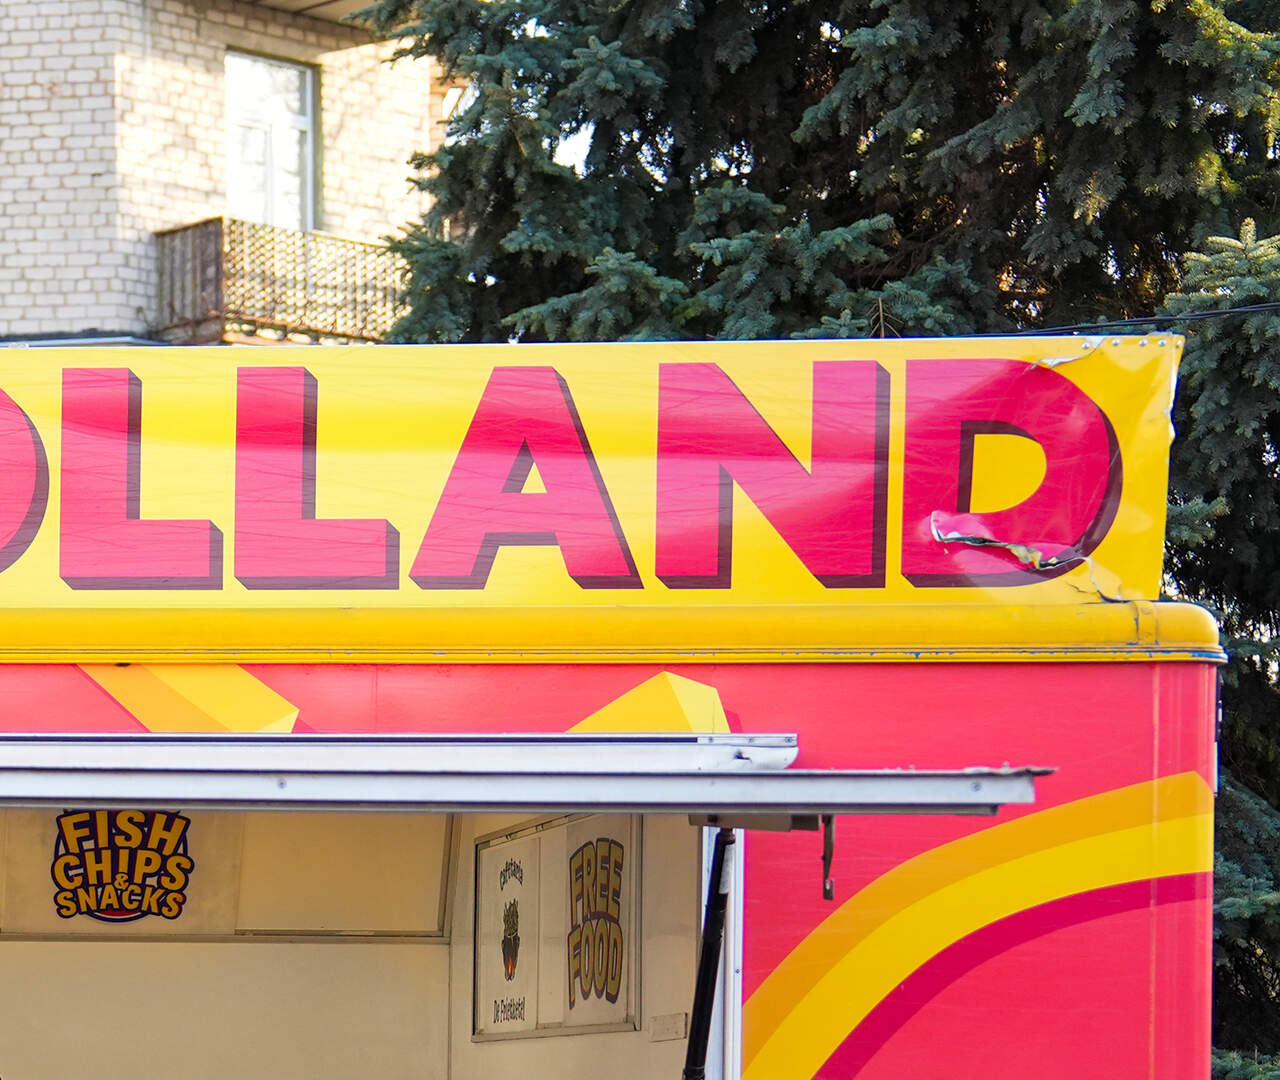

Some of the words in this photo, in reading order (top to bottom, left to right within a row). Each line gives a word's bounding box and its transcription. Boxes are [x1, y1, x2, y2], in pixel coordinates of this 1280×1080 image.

[56, 809, 191, 857] FISH
[51, 849, 194, 892] CHIPS
[113, 871, 129, 890] &
[569, 838, 624, 928] FREE
[54, 884, 187, 919] SNACKS
[567, 917, 624, 1010] FOOD
